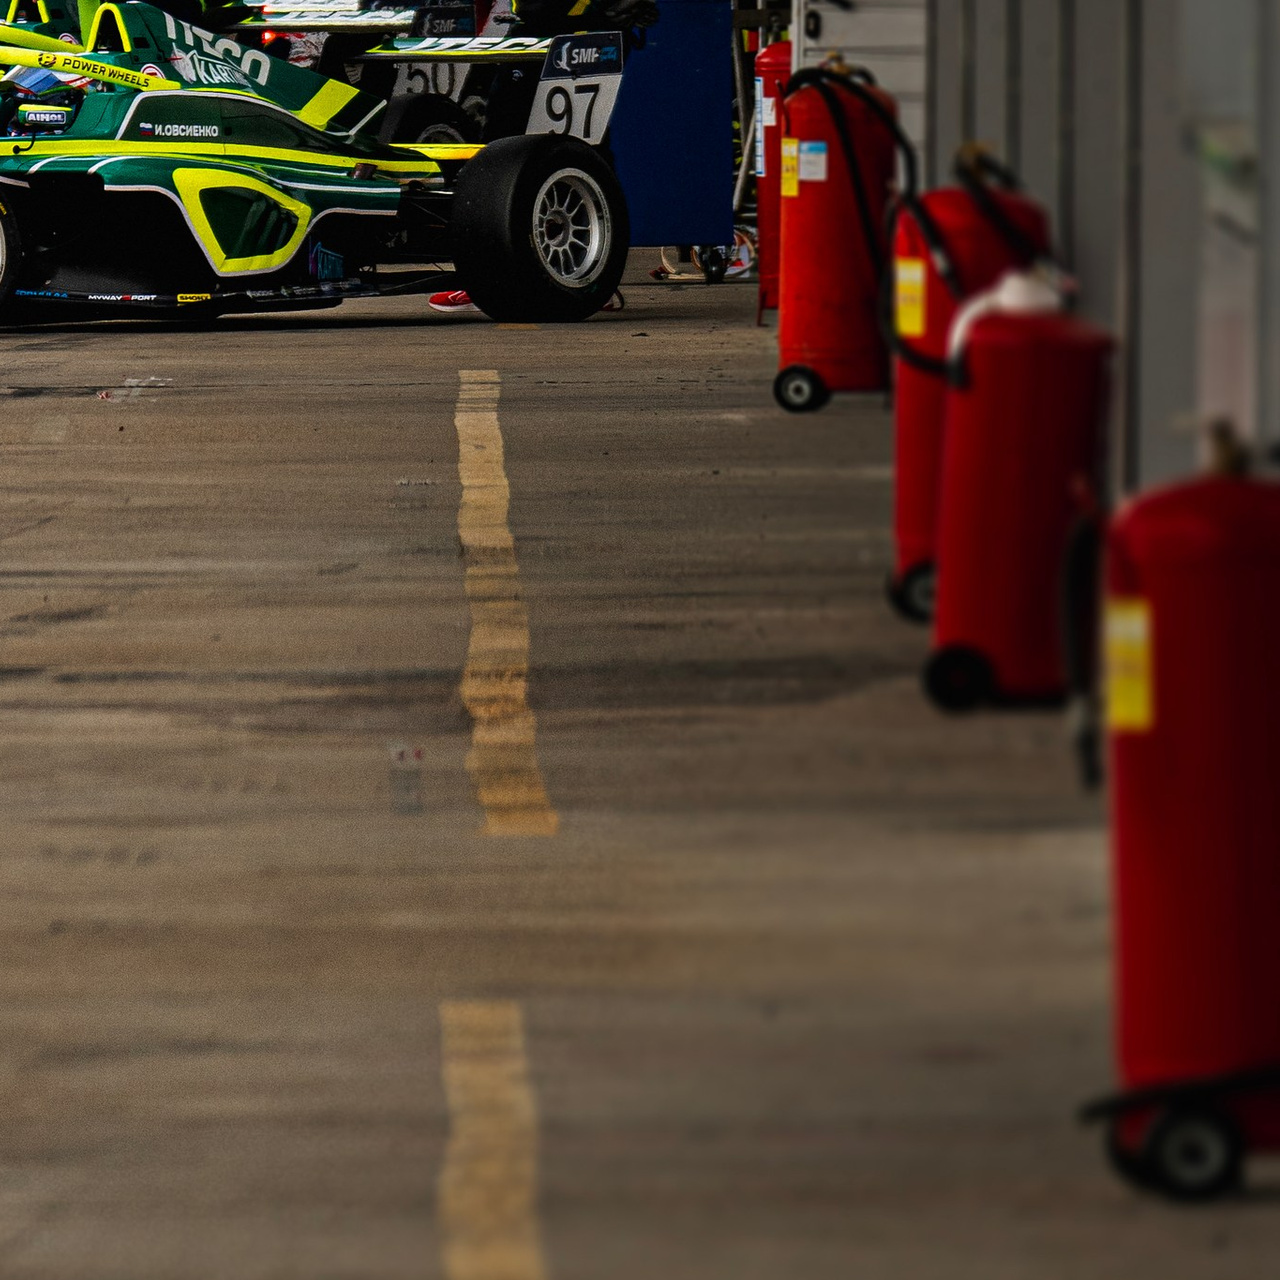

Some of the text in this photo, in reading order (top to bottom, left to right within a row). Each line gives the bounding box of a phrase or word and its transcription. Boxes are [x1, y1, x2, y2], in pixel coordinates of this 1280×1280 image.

[61, 57, 150, 88] POWER WHEELS
[545, 82, 601, 139] 97
[154, 124, 219, 137] И.ОВСИЕНКО
